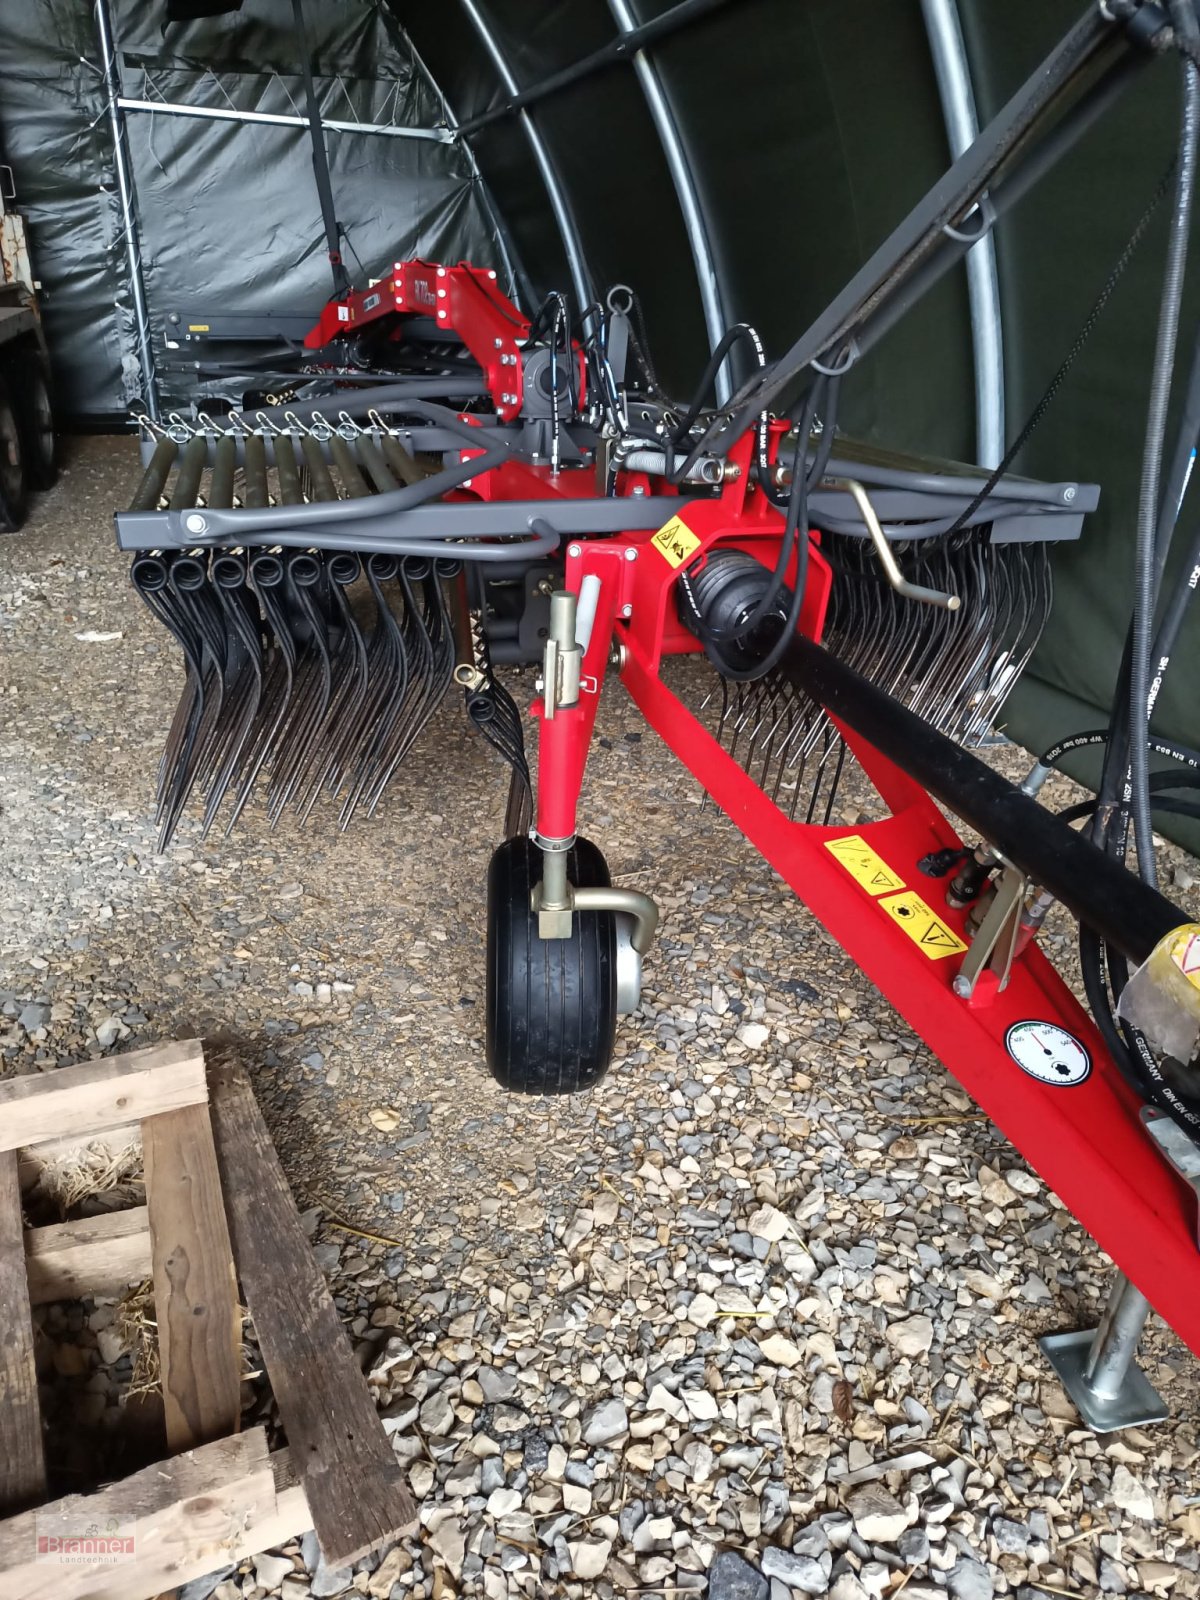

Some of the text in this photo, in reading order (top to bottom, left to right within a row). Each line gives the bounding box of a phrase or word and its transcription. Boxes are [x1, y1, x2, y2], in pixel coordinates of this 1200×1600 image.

[1063, 741, 1076, 749] bar
[1172, 751, 1185, 761] EN
[1135, 1037, 1164, 1081] GERMANY
[1162, 1088, 1178, 1102] DIN
[1173, 1102, 1188, 1114] EN
